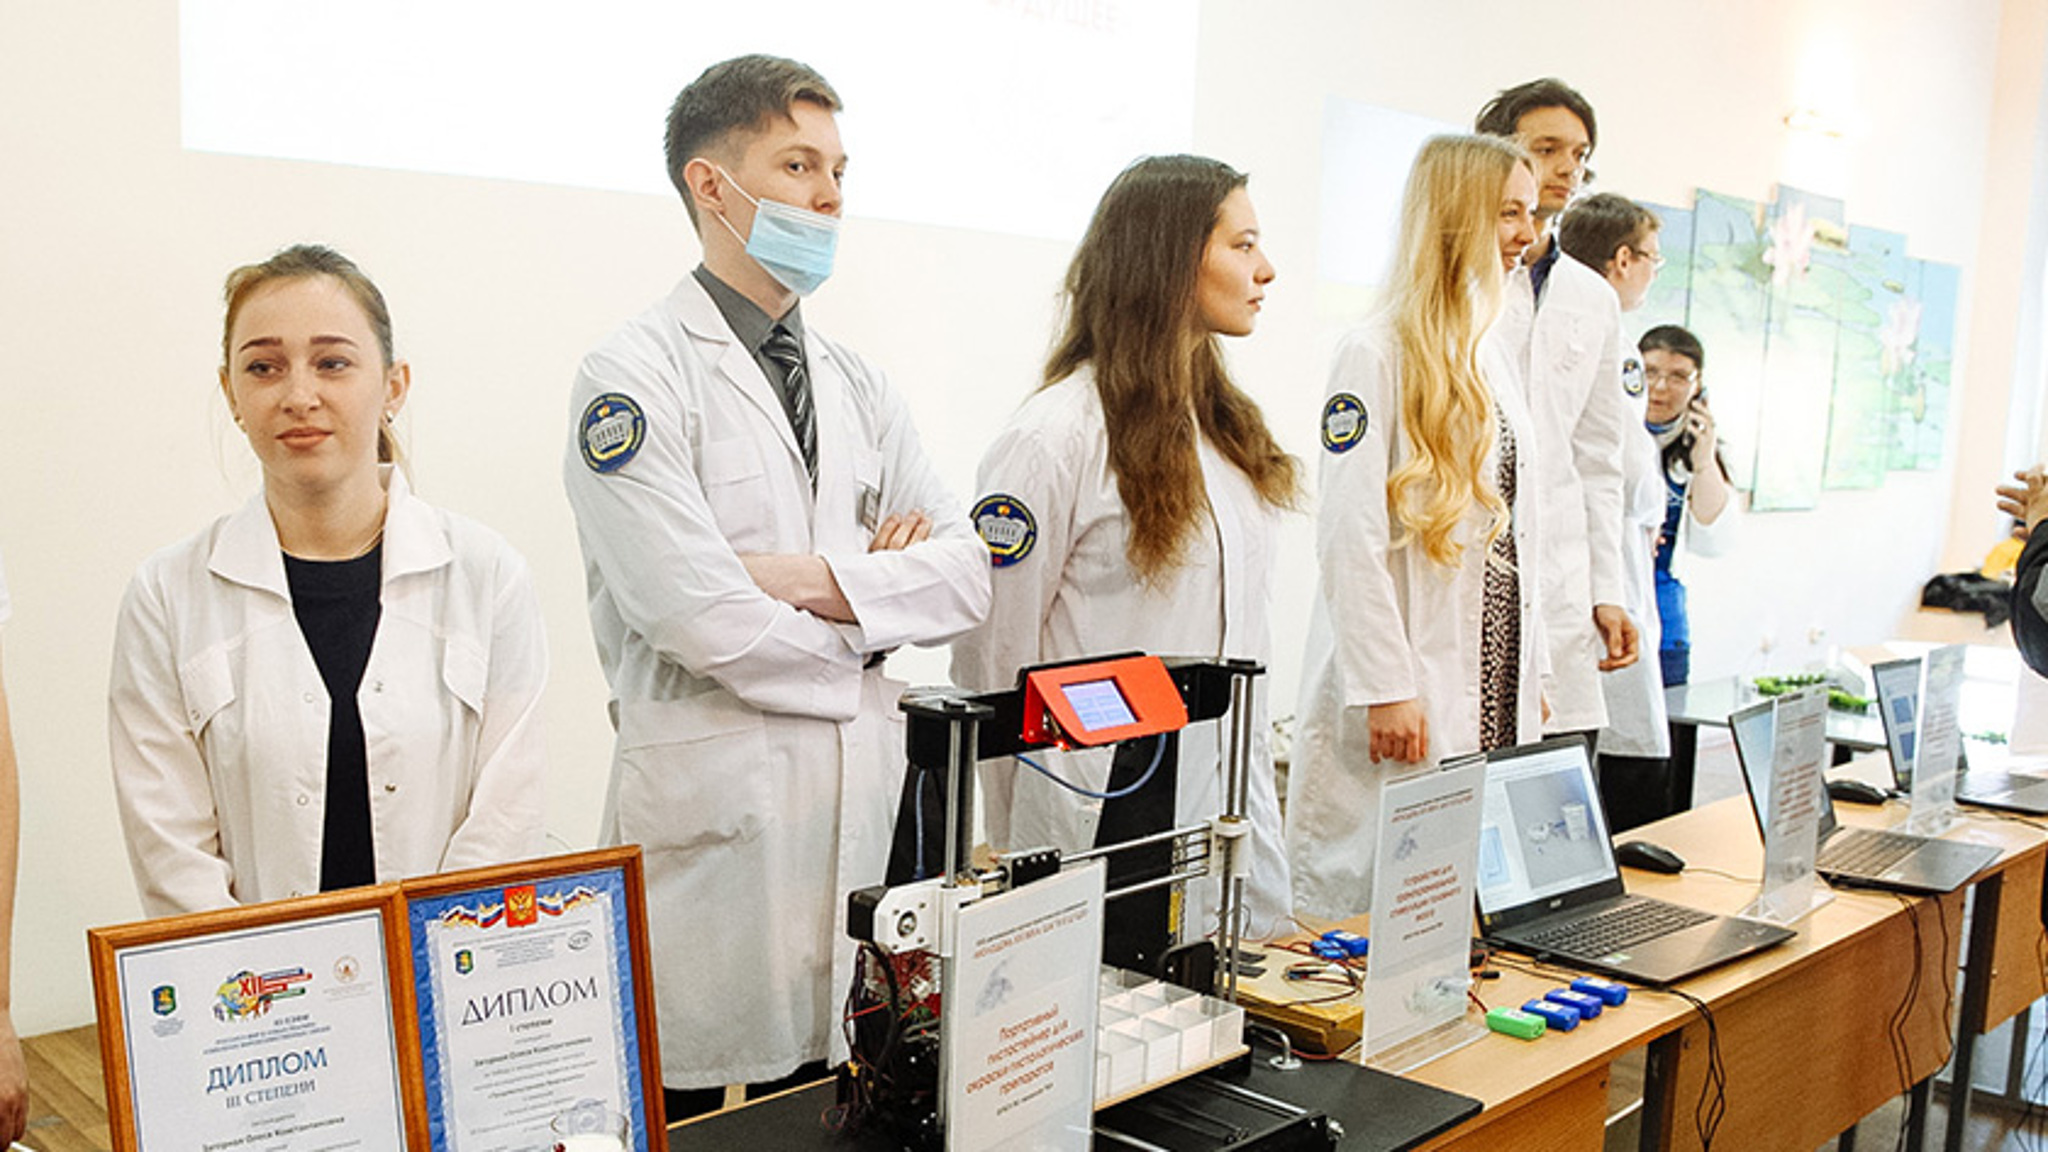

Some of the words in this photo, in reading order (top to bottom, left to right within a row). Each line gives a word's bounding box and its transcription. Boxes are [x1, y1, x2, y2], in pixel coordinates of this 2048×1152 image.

[461, 976, 599, 1026] ДИПЛОМ
[206, 1047, 328, 1094] ДИПЛОМ
[225, 1096, 241, 1109] III
[245, 1079, 316, 1105] СТЕПЕНИ
